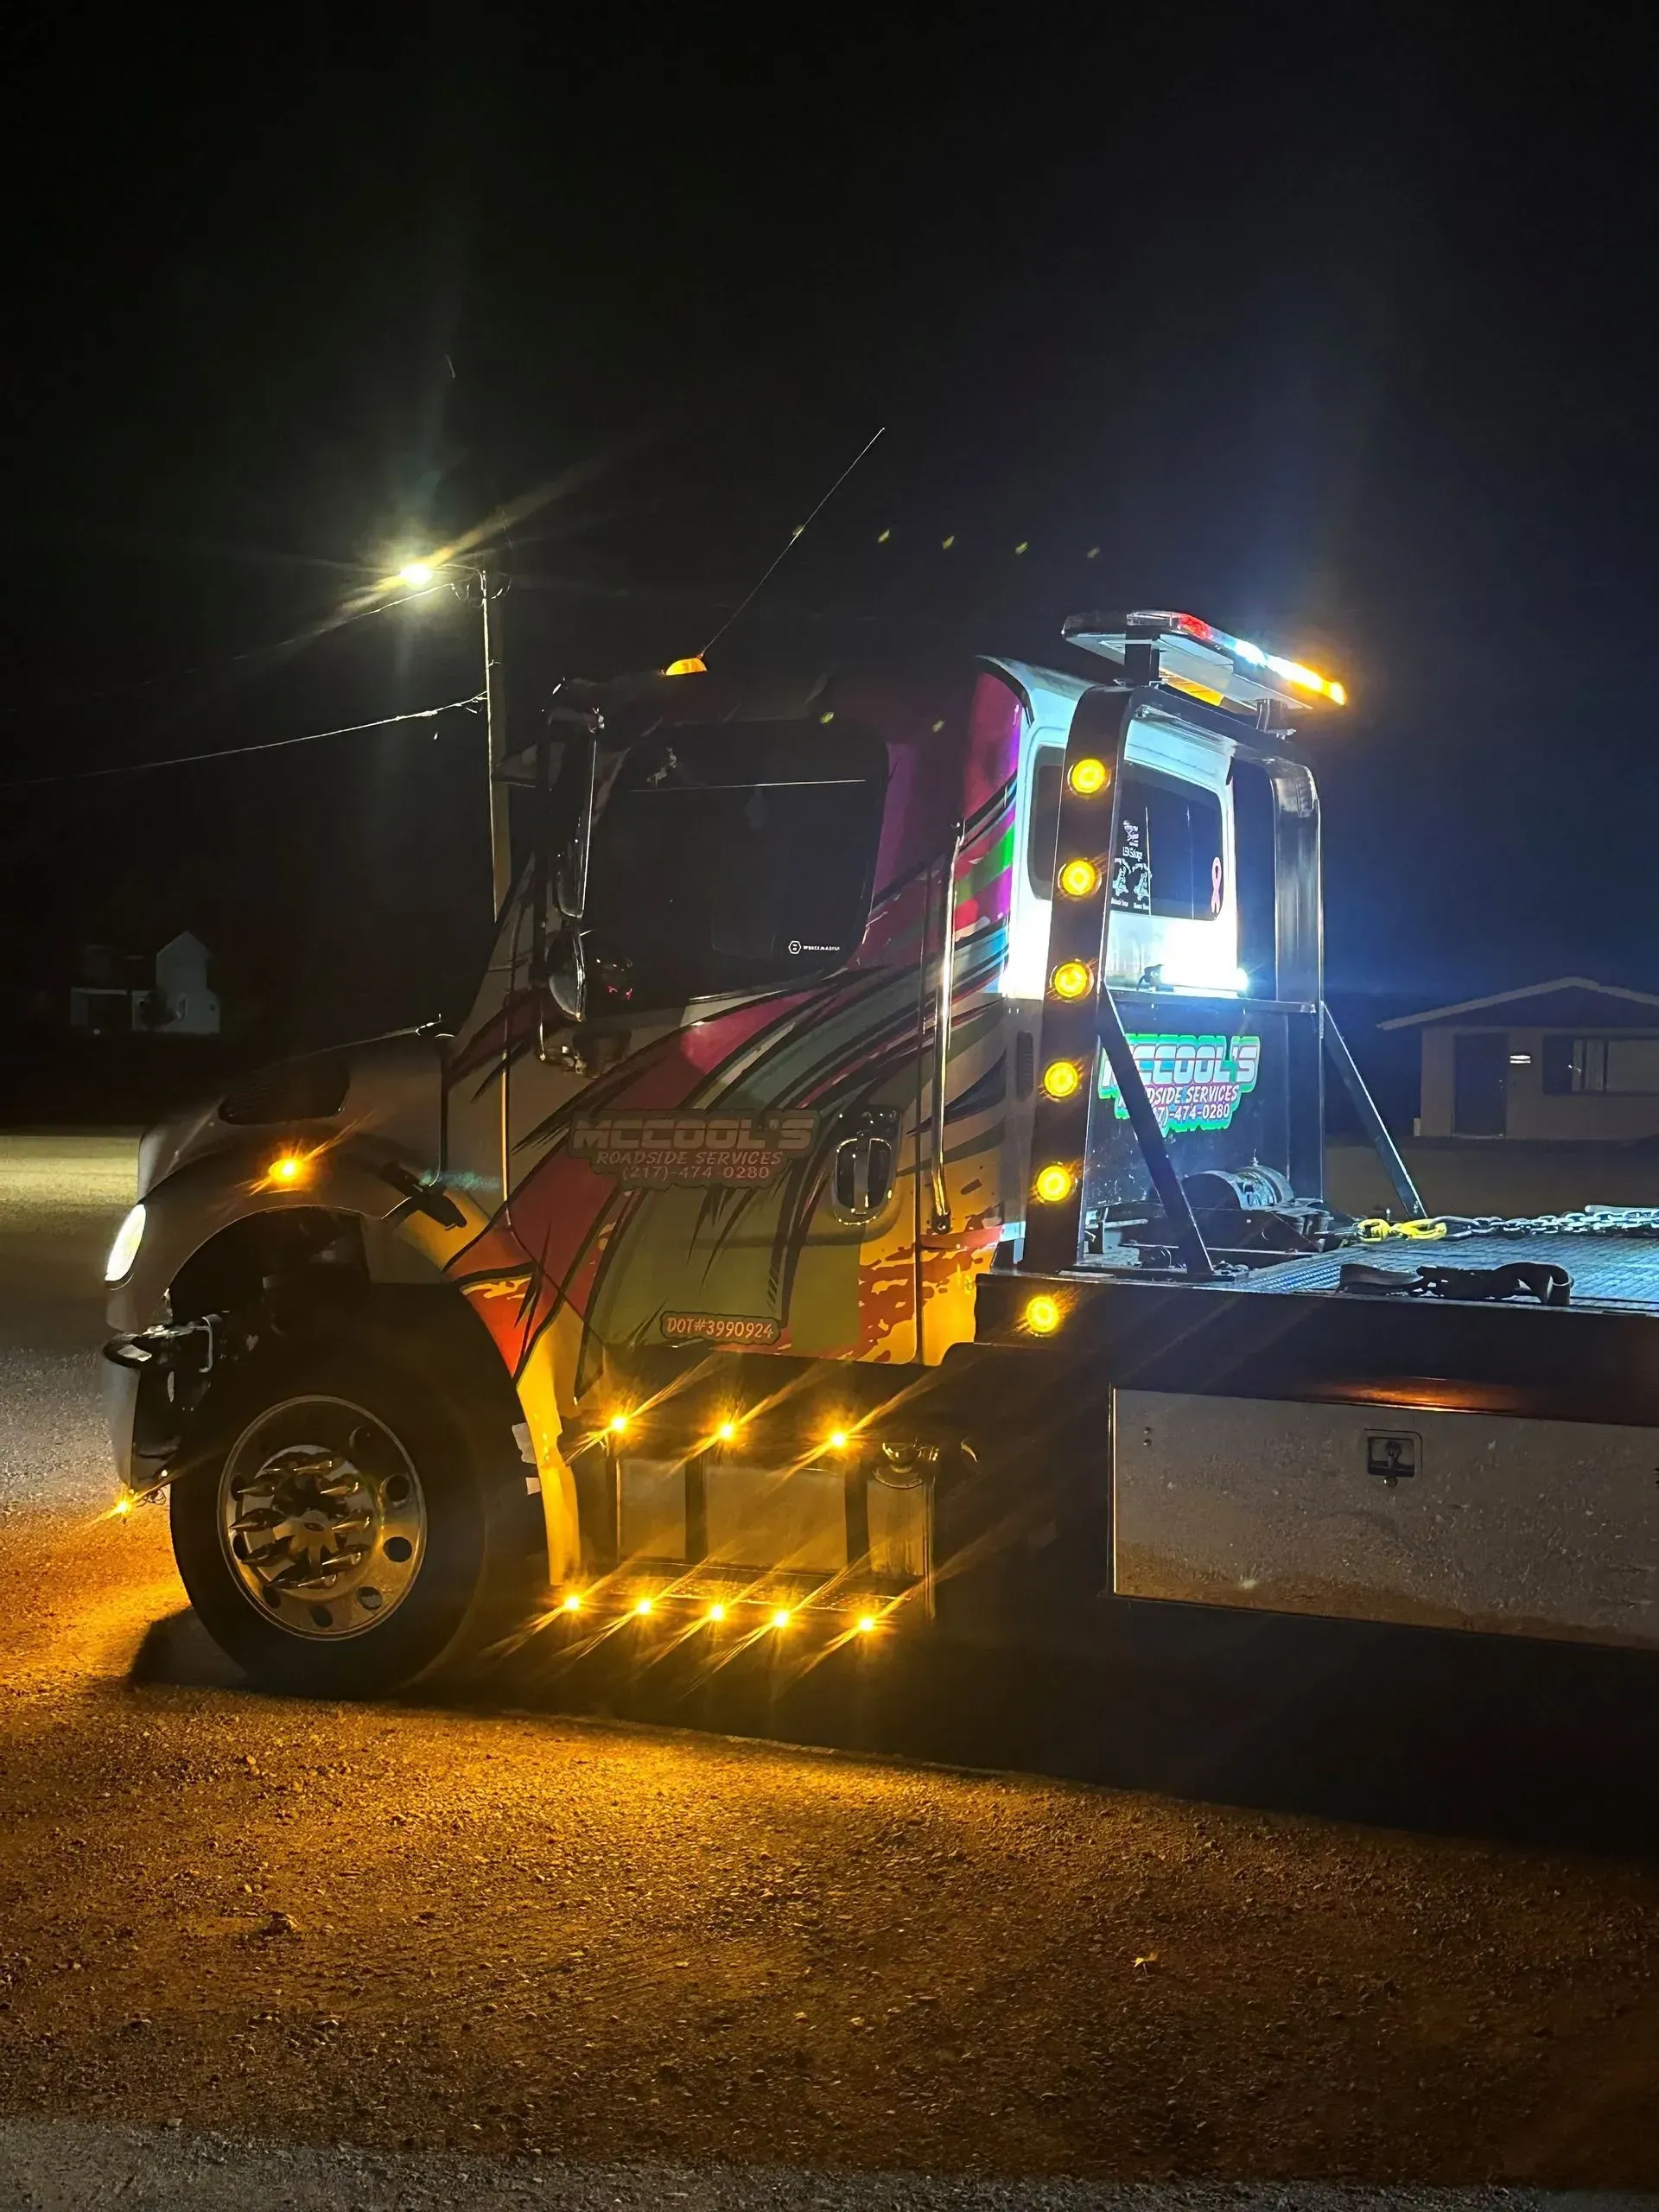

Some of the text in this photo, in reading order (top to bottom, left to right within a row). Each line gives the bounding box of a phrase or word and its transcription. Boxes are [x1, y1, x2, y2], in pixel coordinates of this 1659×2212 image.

[1185, 1084, 1240, 1104] SERVICES
[1154, 1103, 1230, 1126] 7)-474-0280
[572, 1118, 815, 1149] MCCOOL'S
[596, 1150, 784, 1165] ROADSIDE SERVICES
[621, 1165, 770, 1181] (217)-474-0280
[666, 1317, 774, 1338] DOT#3990924
